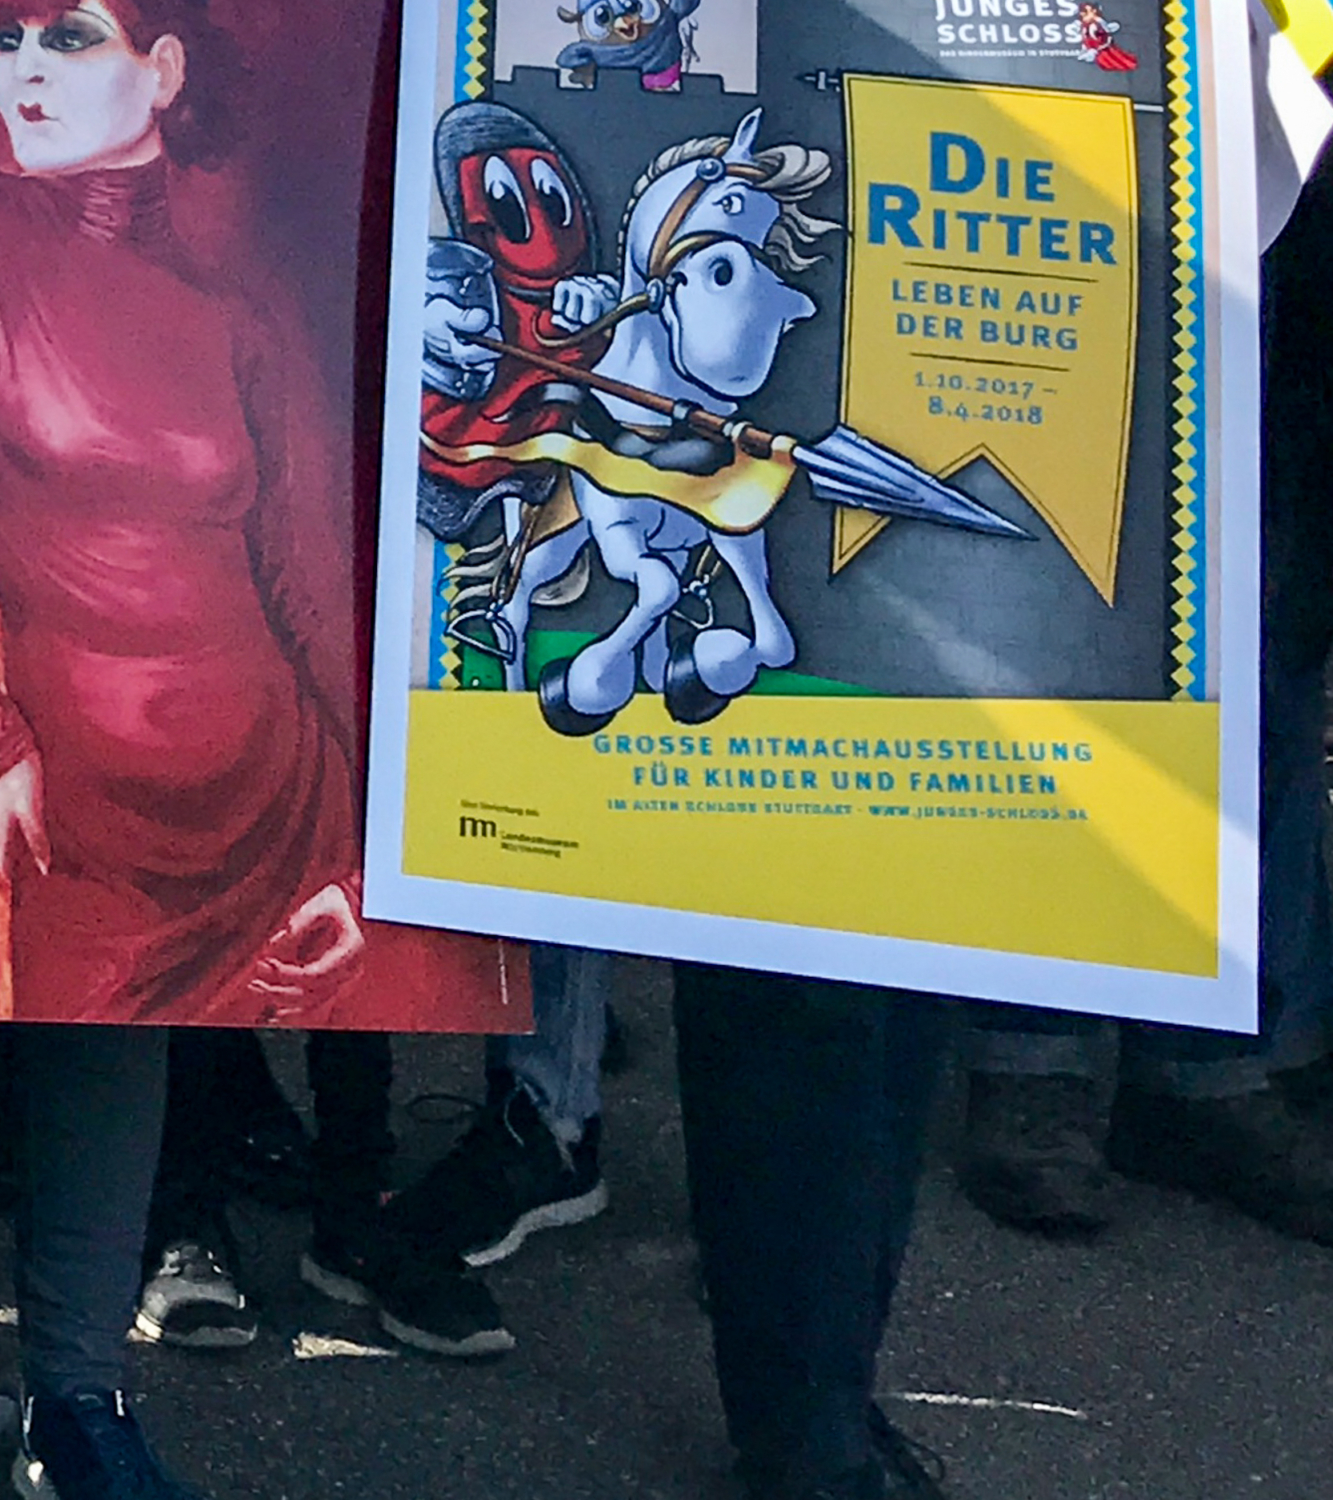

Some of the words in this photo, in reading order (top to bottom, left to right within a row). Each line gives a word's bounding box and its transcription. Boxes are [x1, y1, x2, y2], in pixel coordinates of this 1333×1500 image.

[936, 23, 1083, 44] SCHLOSS
[891, 278, 1002, 311] LEBEN
[1014, 290, 1084, 317] AUF
[896, 312, 965, 342] DER
[980, 318, 1079, 351] BURG
[913, 371, 1035, 400] 1.10.2017
[927, 396, 1044, 426] 8.4.2018
[593, 734, 714, 757] GROSSE
[728, 736, 1093, 763] MITMACHAUSSTELLUNG
[633, 763, 691, 788] FÜR
[703, 767, 821, 792] KINDER
[832, 770, 896, 794] UND
[909, 770, 1058, 795] FAMILIEN
